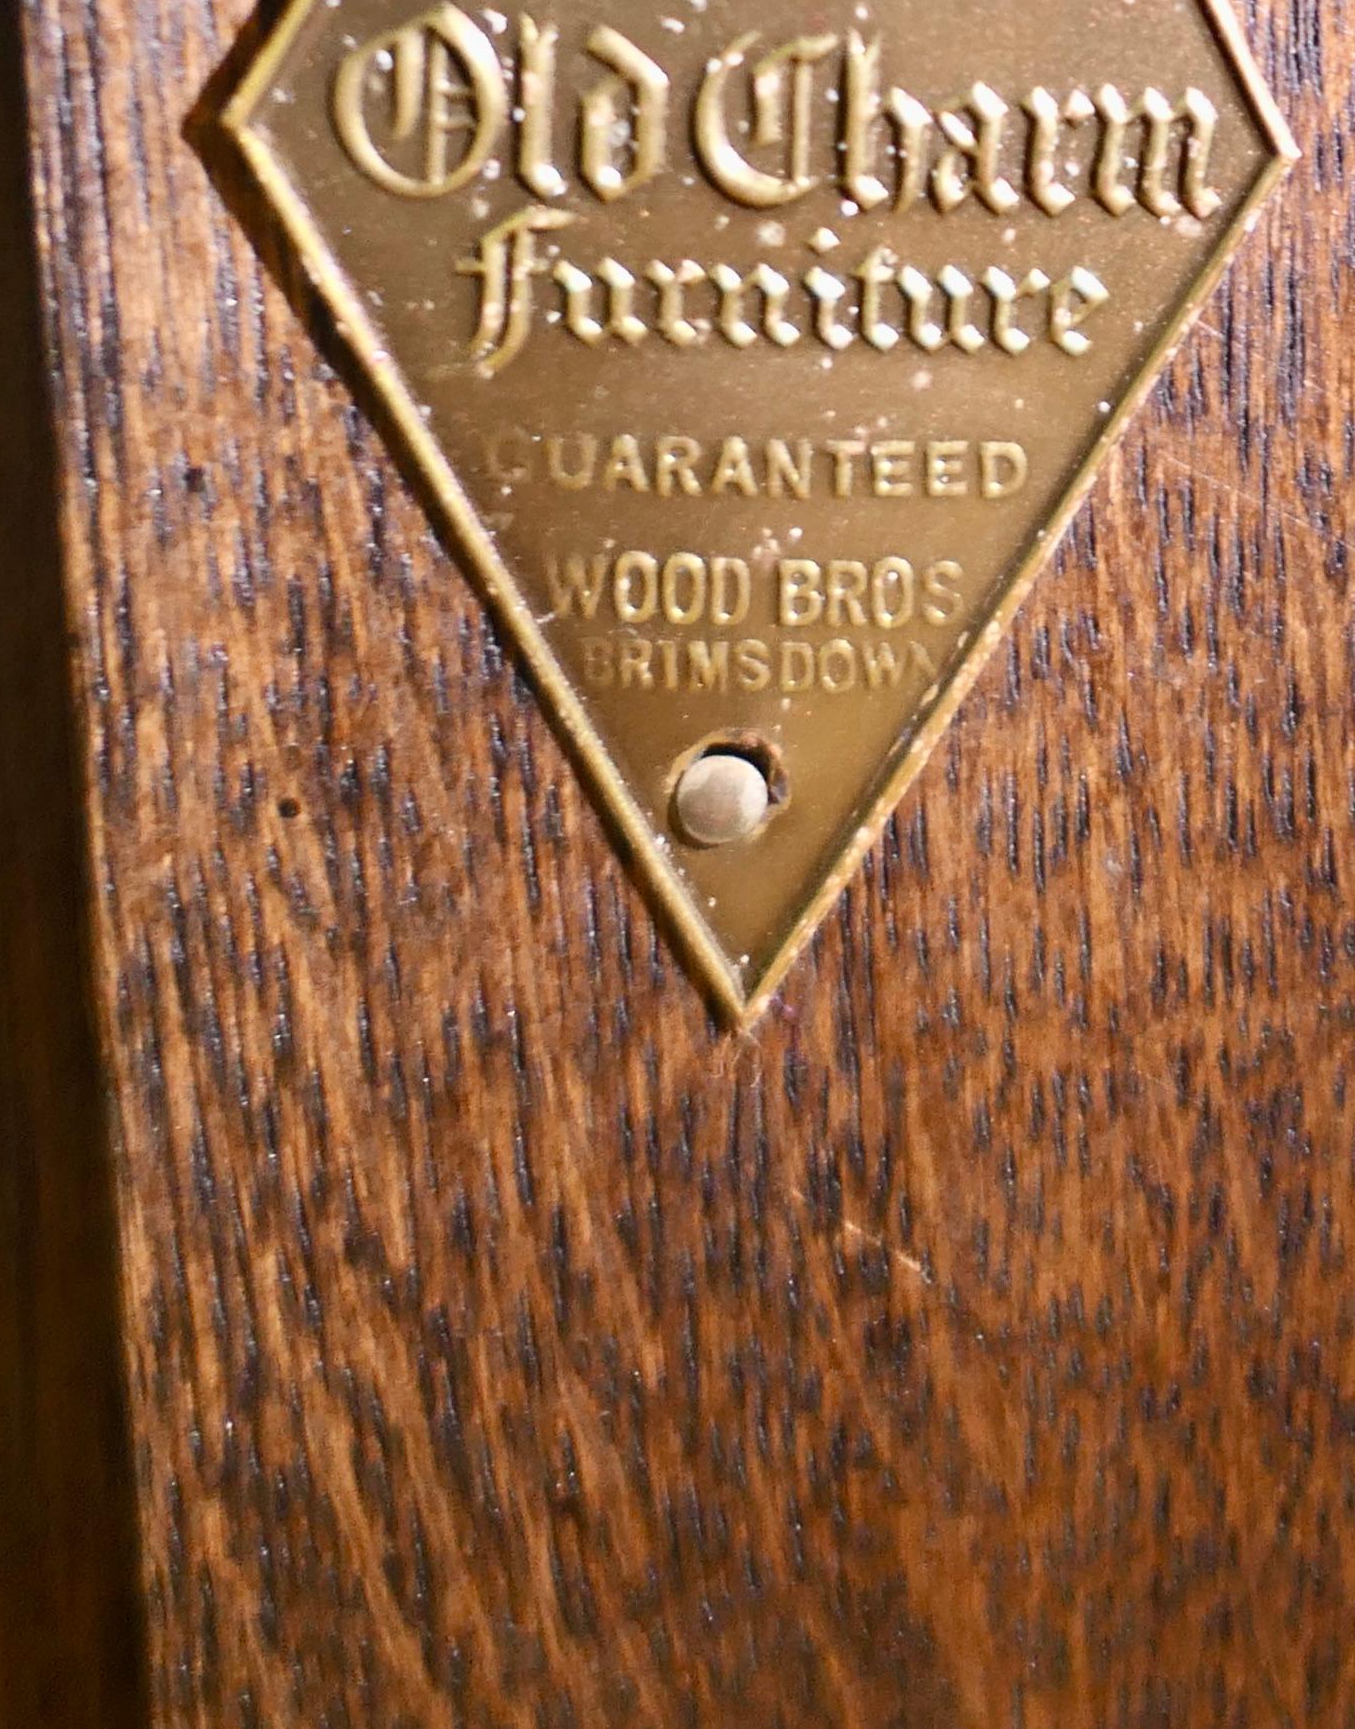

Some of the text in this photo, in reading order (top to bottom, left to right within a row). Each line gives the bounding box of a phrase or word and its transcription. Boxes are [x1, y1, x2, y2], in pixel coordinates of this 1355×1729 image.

[331, 0, 1222, 220] Old Charm
[457, 206, 1110, 376] Furniture
[547, 549, 964, 629] WOOD BROS
